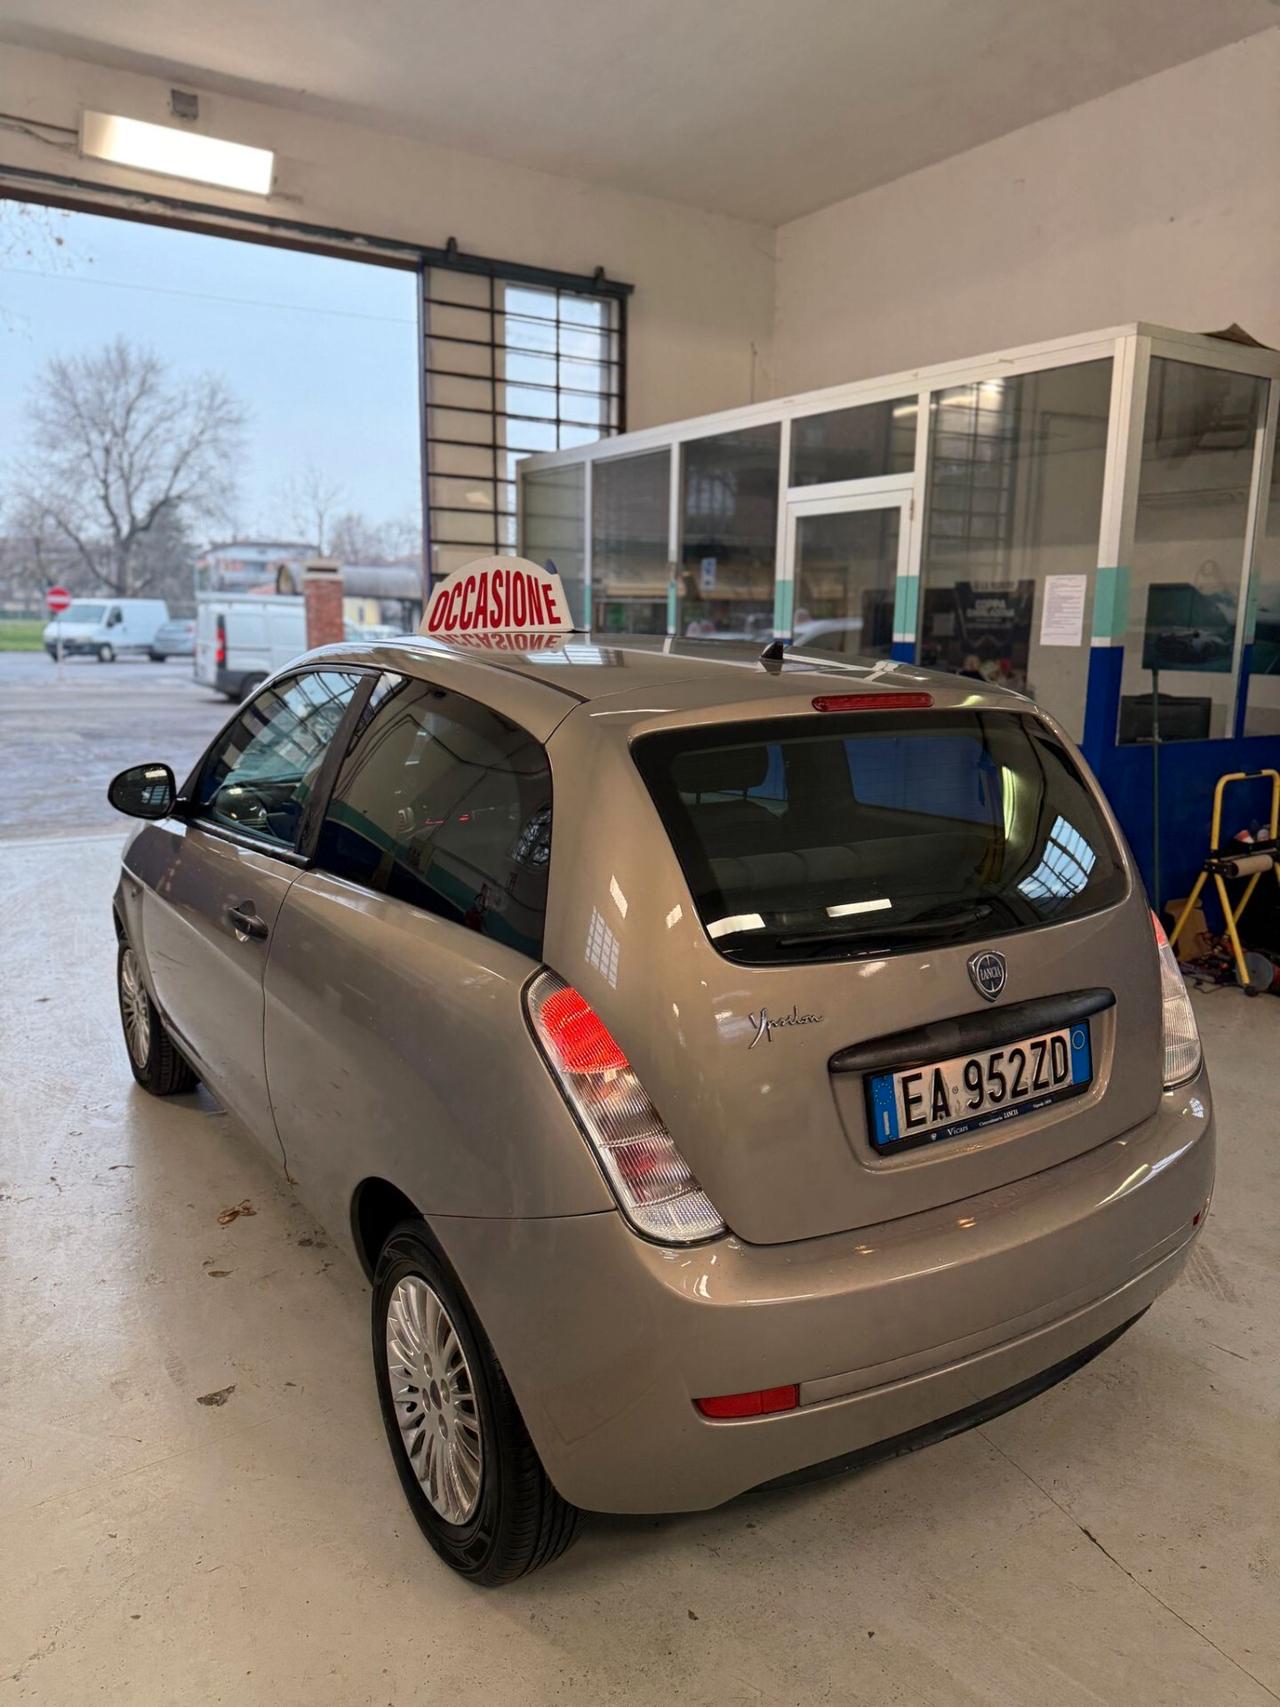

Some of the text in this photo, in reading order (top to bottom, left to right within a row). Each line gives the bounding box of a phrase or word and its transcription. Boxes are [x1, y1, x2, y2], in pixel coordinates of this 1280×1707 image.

[428, 569, 562, 632] OCCASIONE
[748, 1004, 824, 1050] Ypsilon
[901, 1067, 951, 1129] EA
[963, 1035, 1069, 1109] 952ZD
